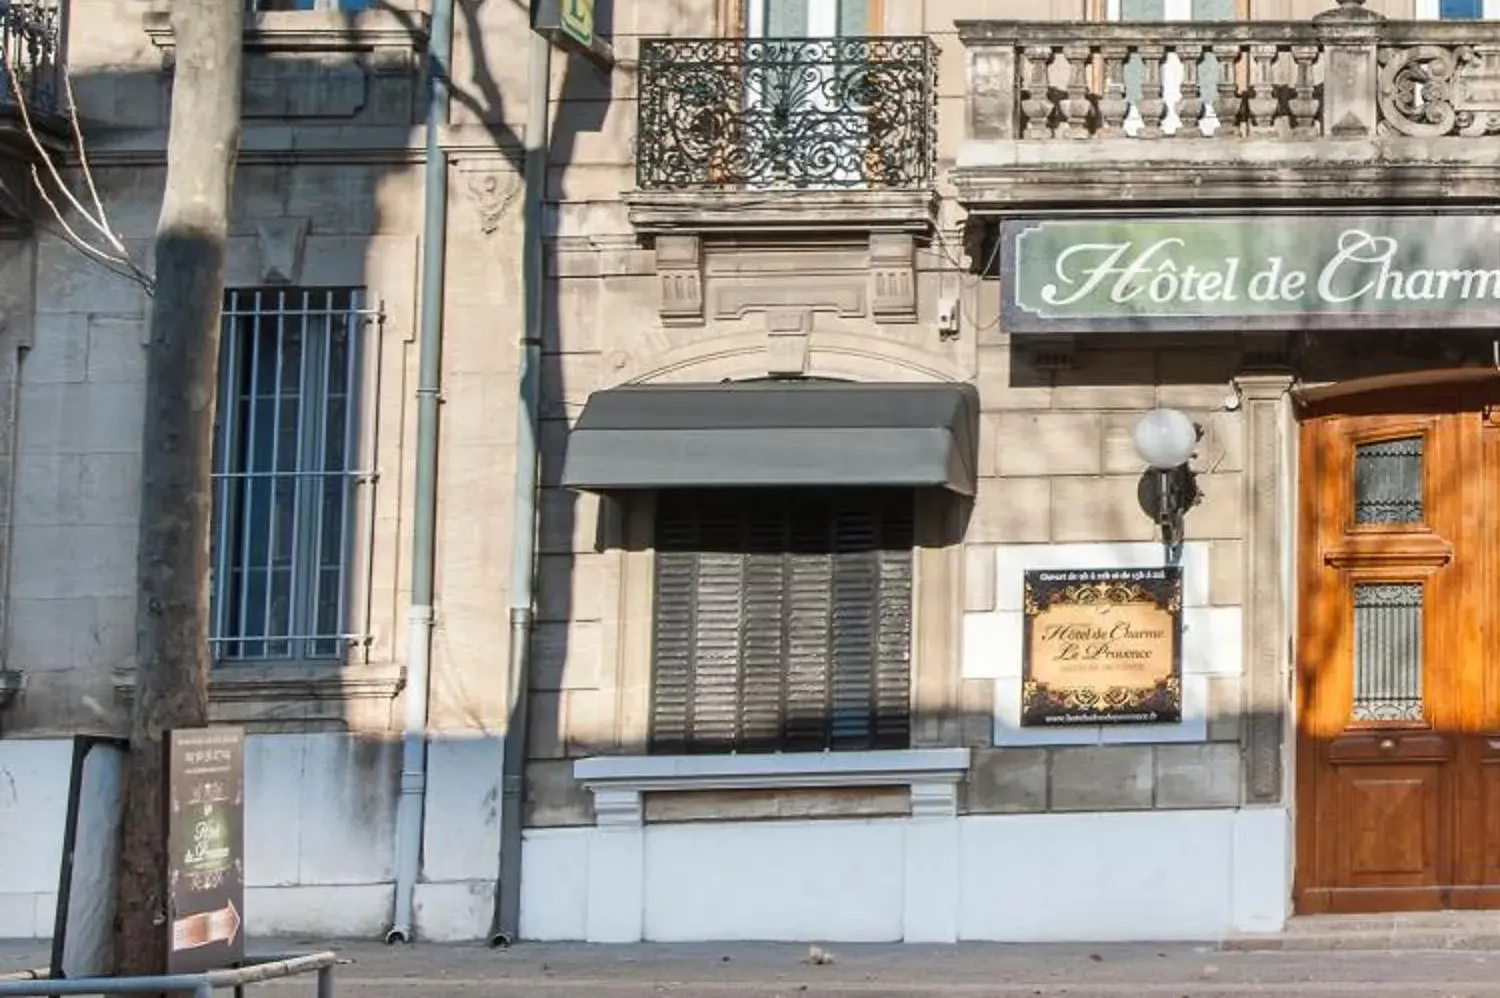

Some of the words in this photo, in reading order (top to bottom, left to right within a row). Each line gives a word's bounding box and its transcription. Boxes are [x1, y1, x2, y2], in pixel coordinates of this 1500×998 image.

[1041, 237, 1238, 305] Hôtel
[1248, 258, 1305, 302] de
[1041, 621, 1090, 641] Hôtel
[1092, 626, 1107, 640] de
[1109, 620, 1164, 640] Charme
[1053, 642, 1080, 661] Le
[1081, 643, 1153, 661] Provence
